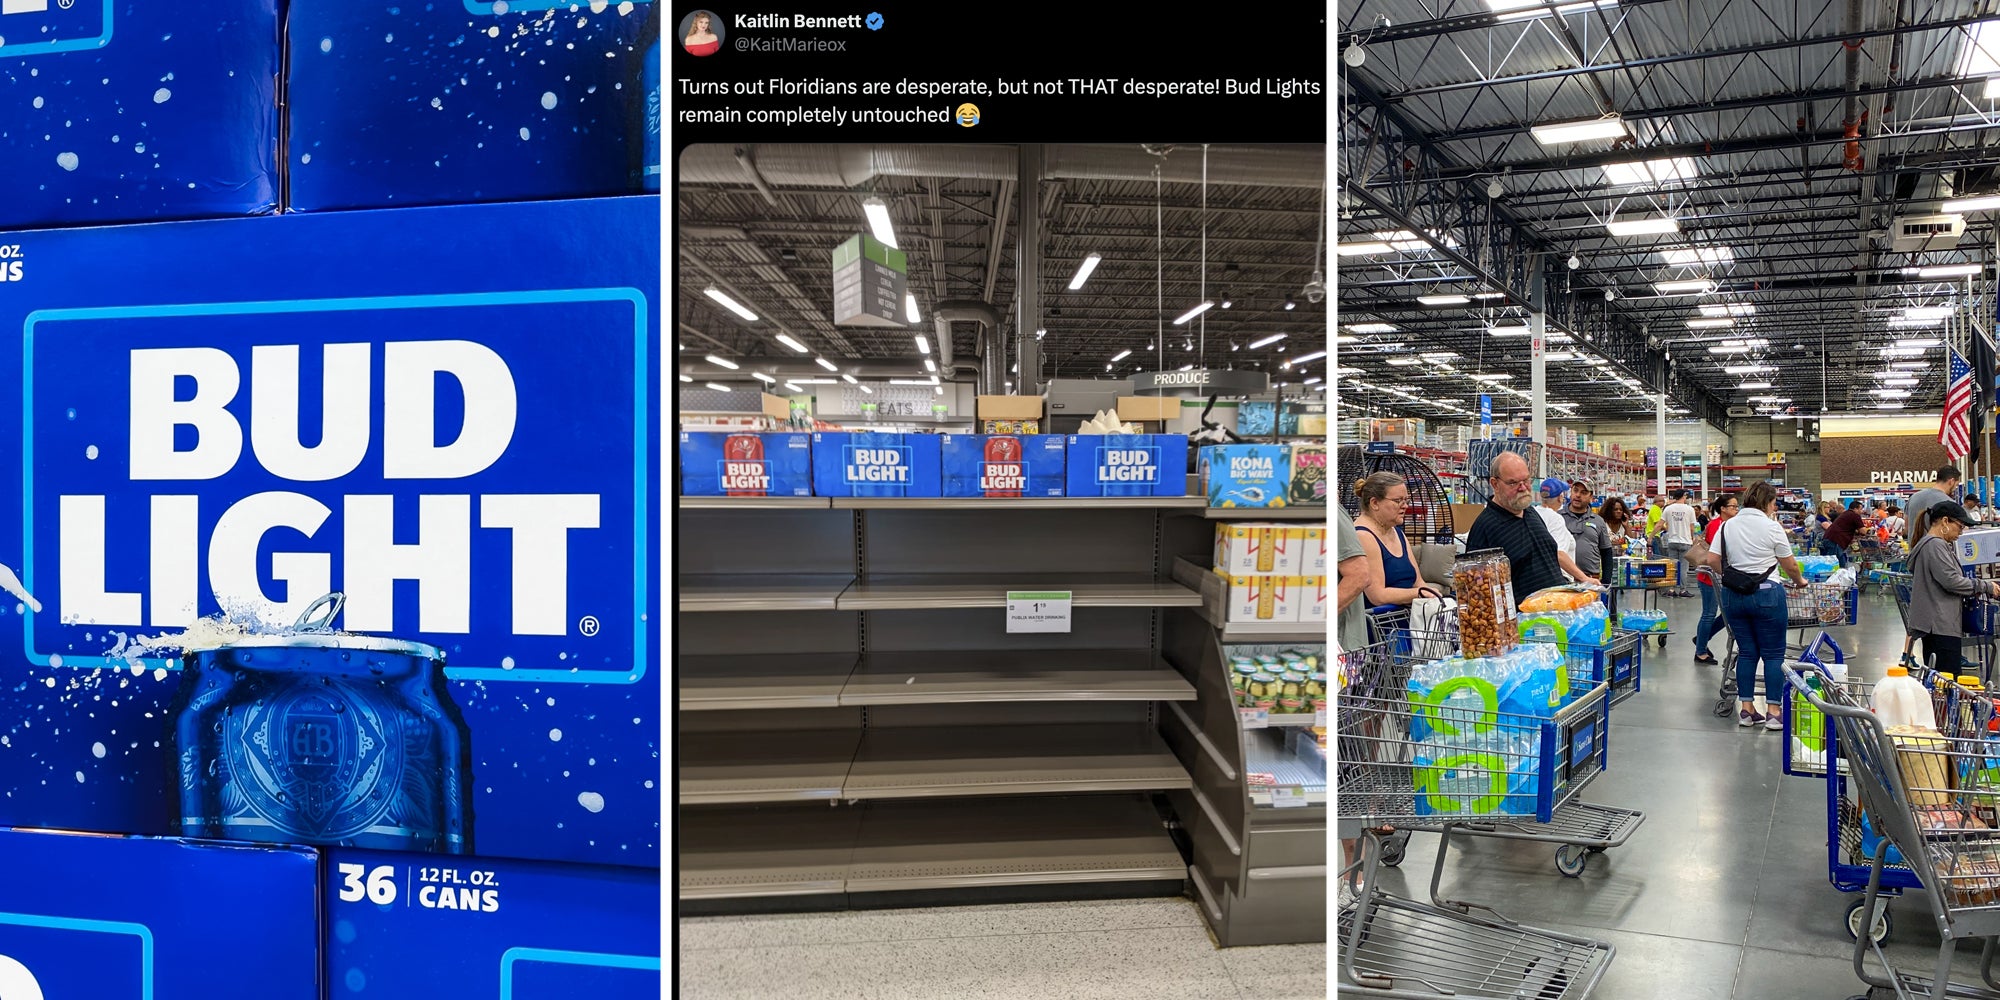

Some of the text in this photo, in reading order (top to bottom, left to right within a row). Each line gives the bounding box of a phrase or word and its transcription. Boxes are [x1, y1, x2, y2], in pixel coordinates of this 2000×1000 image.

[0, 244, 24, 259] OZ.
[1154, 372, 1211, 385] PRODUCE
[129, 340, 517, 481] BUD
[855, 449, 900, 466] BUD
[1107, 450, 1149, 466] BUD
[1231, 457, 1273, 470] KONA
[727, 463, 764, 476] BUD
[847, 465, 909, 482] LIGHT
[986, 464, 1021, 477] BUD
[1099, 465, 1157, 481] LIGHT
[1248, 470, 1274, 479] WAVE
[1870, 470, 1938, 484] PHARMA
[721, 475, 771, 489] LIGHT
[980, 477, 1027, 489] LIGHT
[59, 491, 600, 636] LIGHT
[1033, 602, 1039, 613] 1
[339, 862, 397, 905] 36
[420, 867, 499, 886] 12 FL. OZ.
[419, 885, 499, 913] CANS
